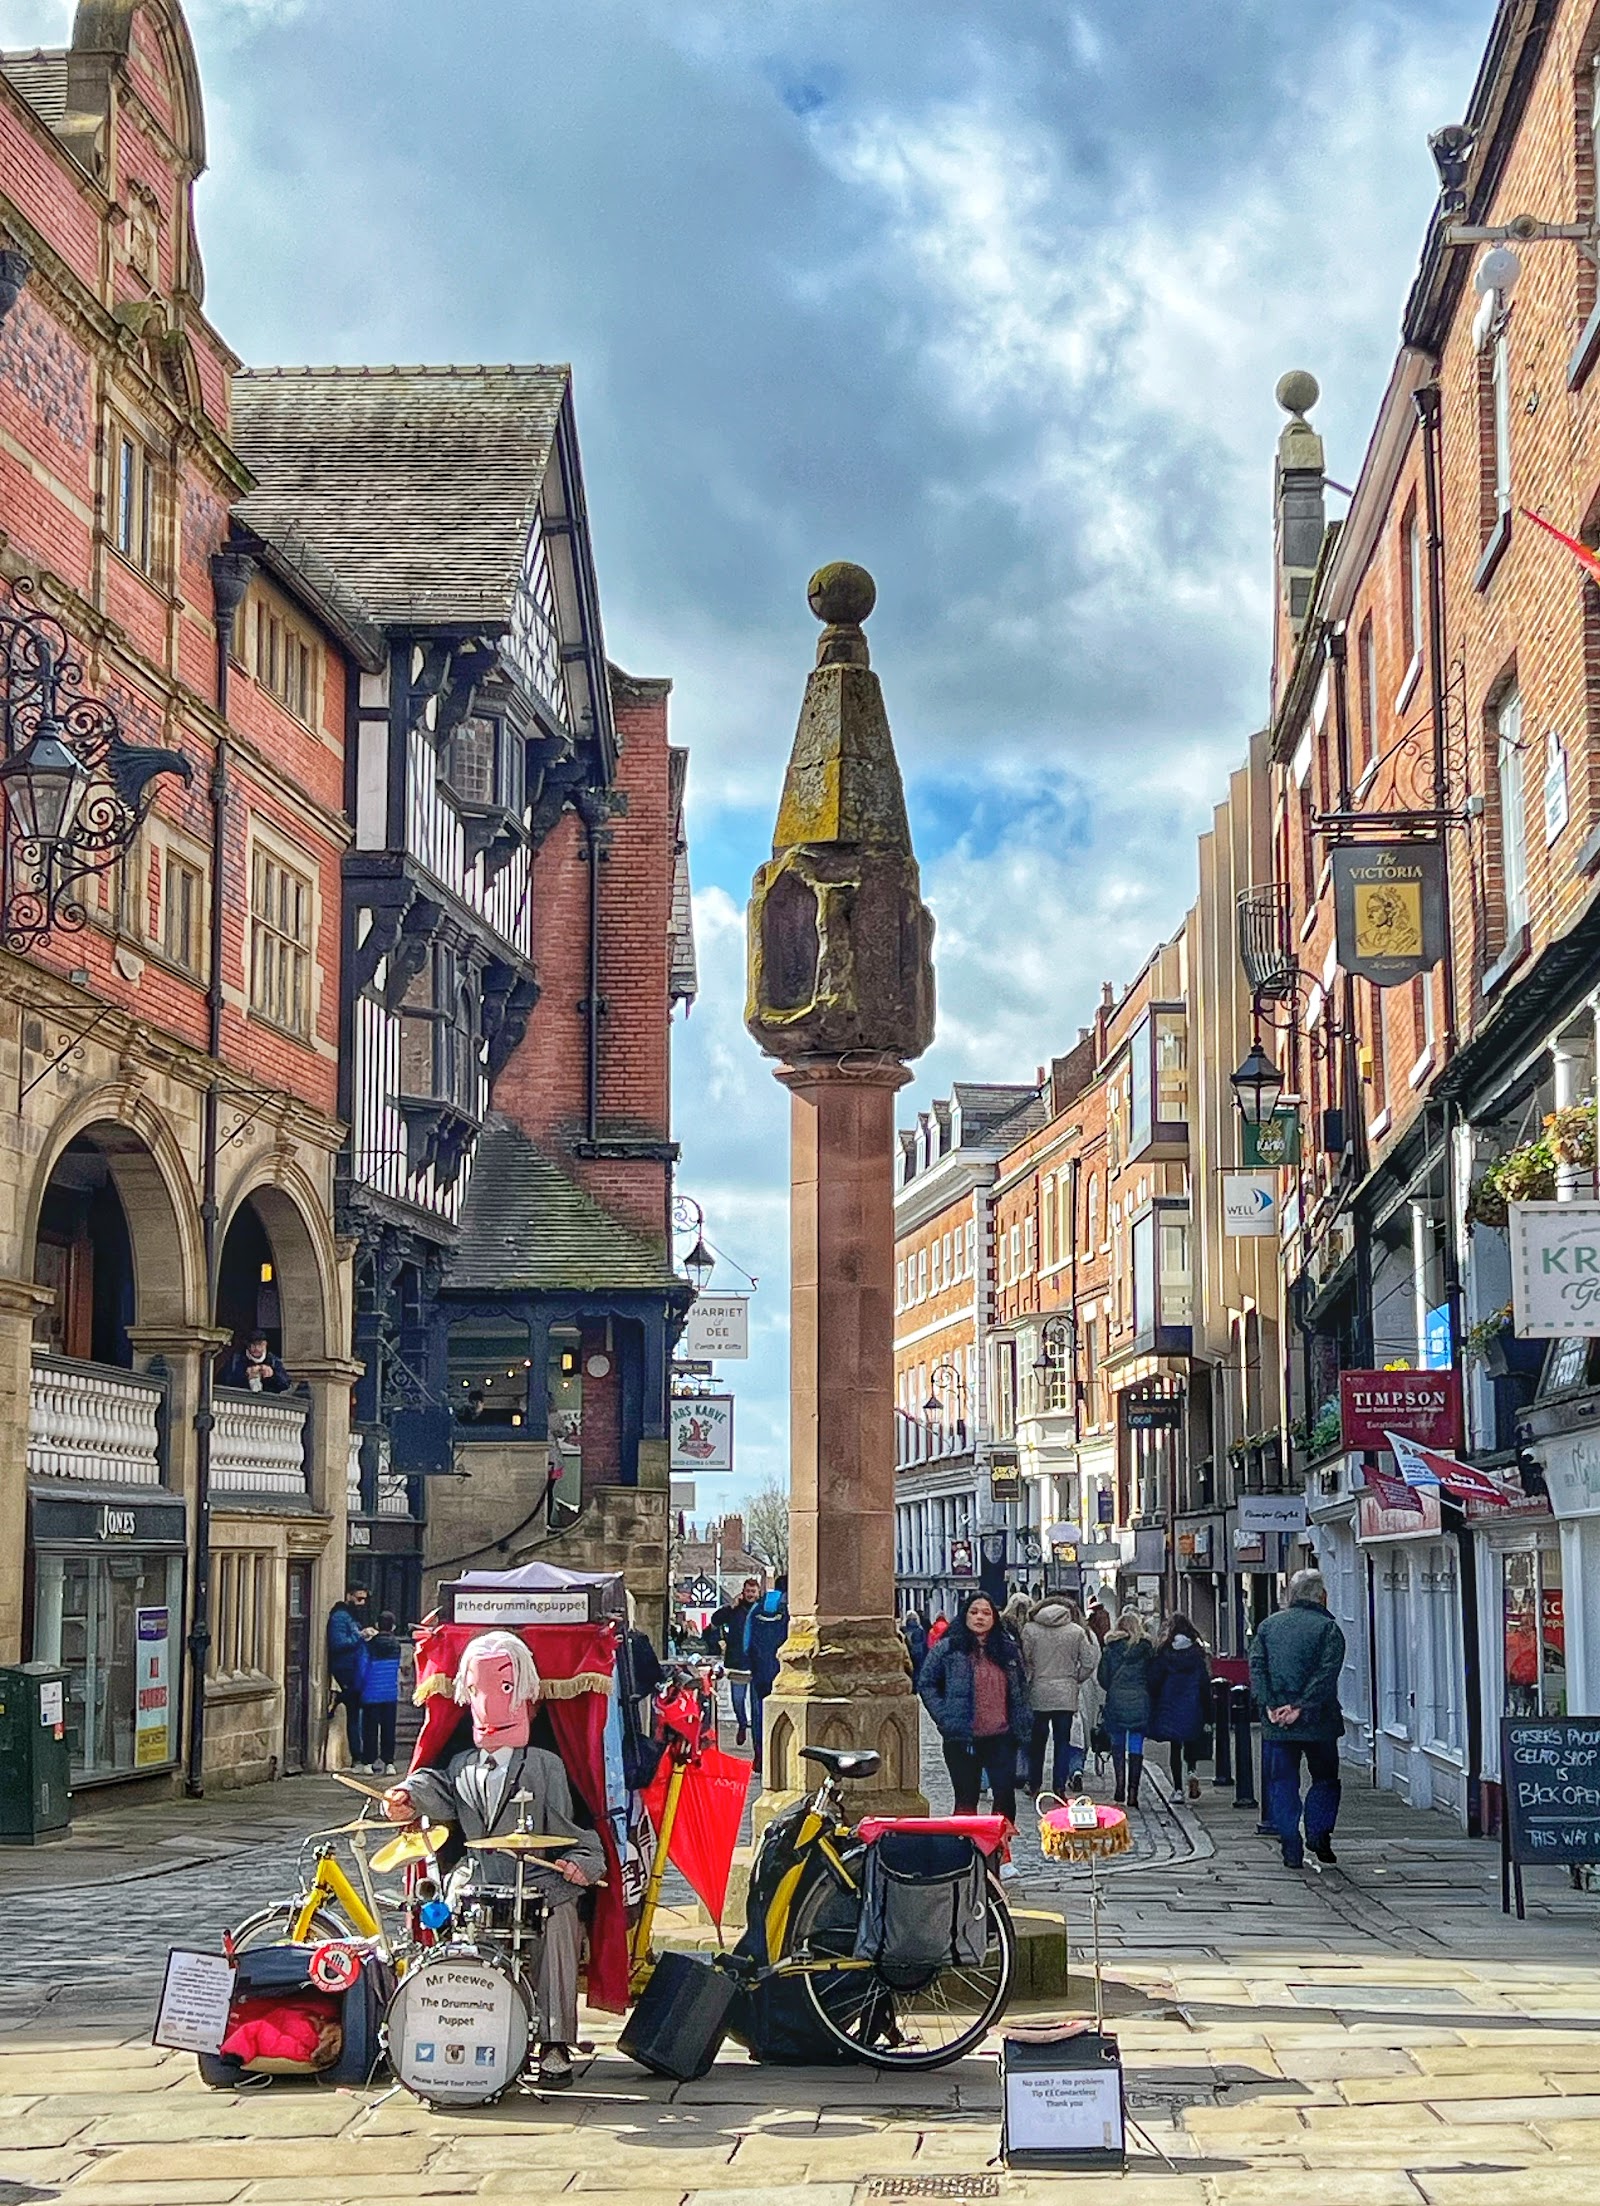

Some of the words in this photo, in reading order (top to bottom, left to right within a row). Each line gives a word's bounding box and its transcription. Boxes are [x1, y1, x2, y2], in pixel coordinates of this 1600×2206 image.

[1376, 852, 1396, 866] The
[1348, 866, 1423, 878] VICTORIA
[1227, 1206, 1254, 1216] WELL
[692, 1308, 742, 1317] HARRIET
[706, 1328, 729, 1336] DEE
[1352, 1392, 1446, 1406] TIMPSON
[1128, 1414, 1152, 1424] Local
[456, 1600, 586, 1613] #thedrummingpuppet
[1514, 1747, 1560, 1766] GELATO
[1562, 1750, 1598, 1766] SHOP
[1556, 1767, 1568, 1781] IS
[1518, 1782, 1561, 1808] BACK
[1524, 1829, 1557, 1848] THIS
[1560, 1828, 1587, 1846] WAY
[426, 1974, 444, 1987] Mr
[448, 1973, 495, 1990] Peewee
[420, 1998, 439, 2008] The
[442, 1998, 495, 2012] Drumming
[438, 2015, 474, 2026] Puppet
[1074, 2078, 1104, 2086] problem
